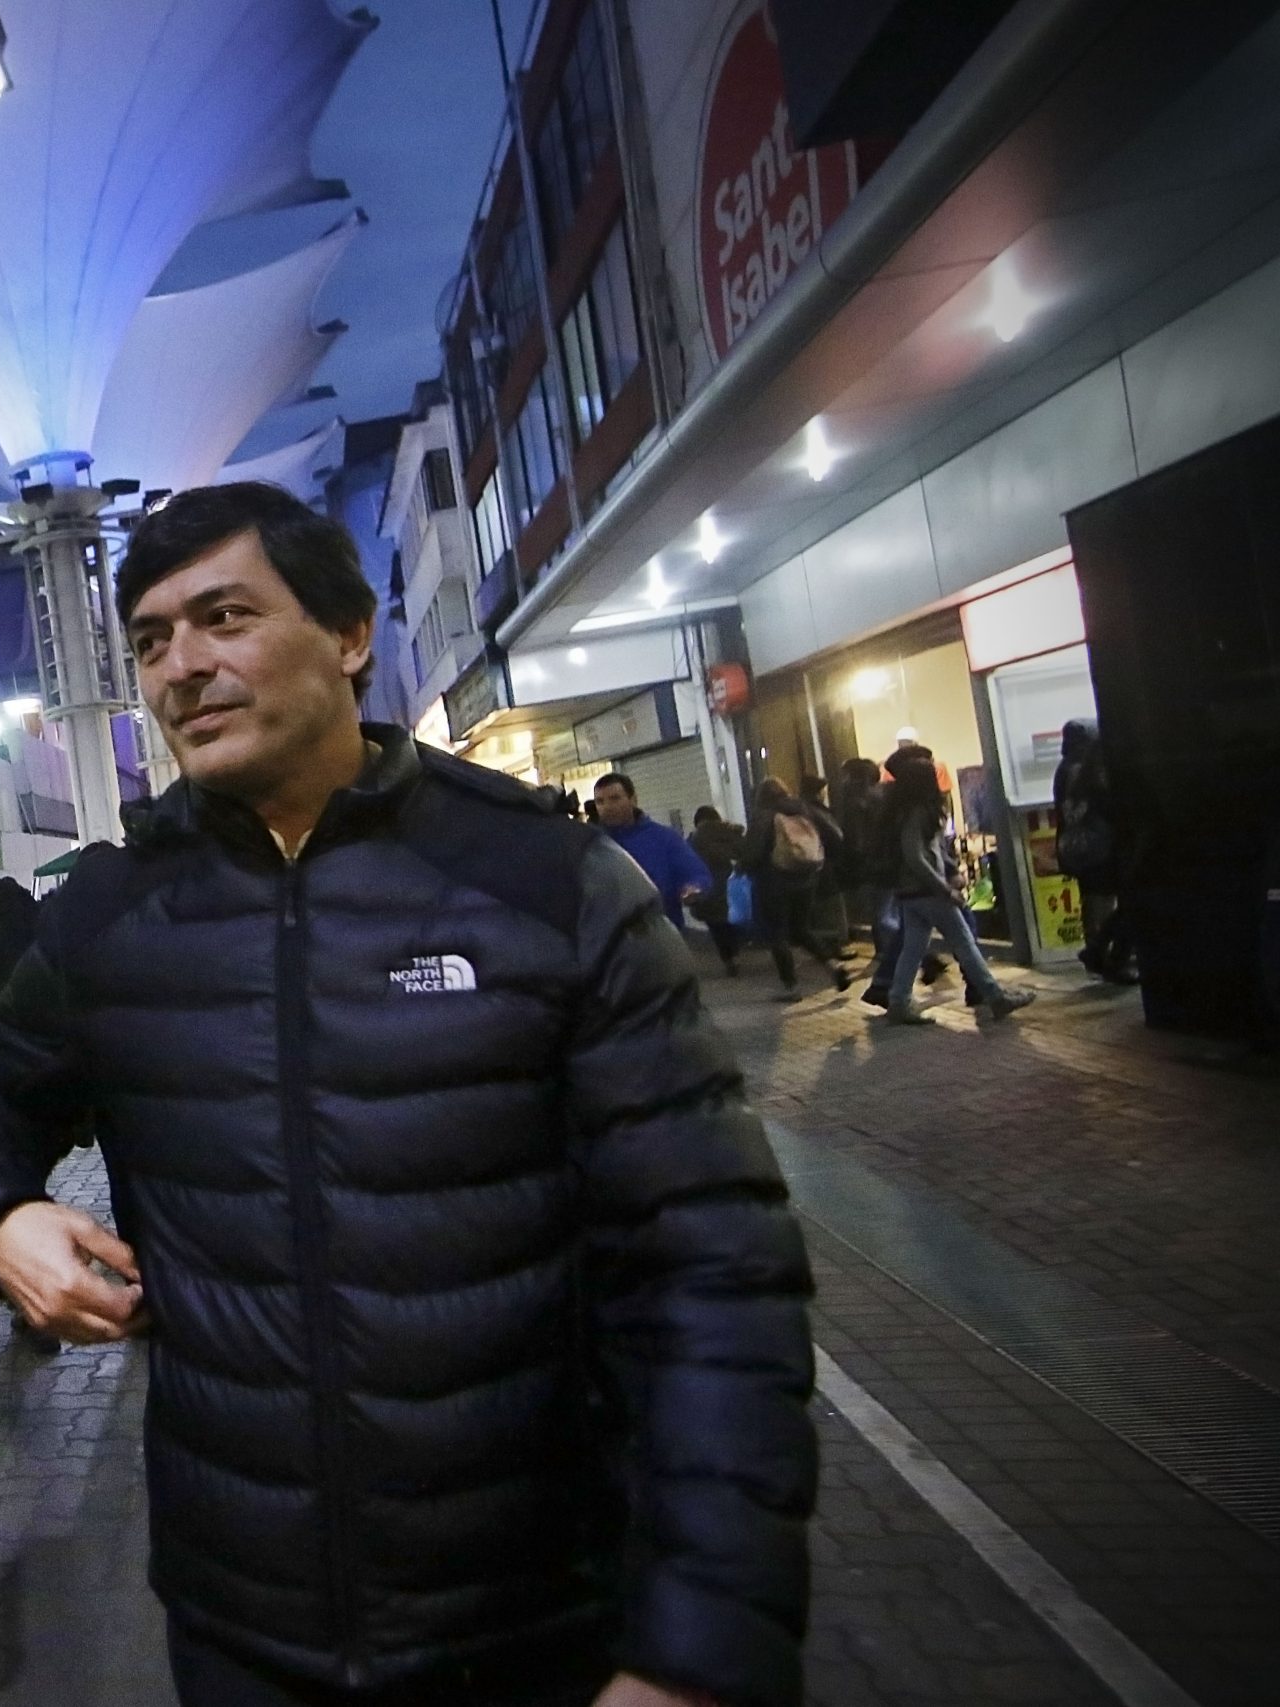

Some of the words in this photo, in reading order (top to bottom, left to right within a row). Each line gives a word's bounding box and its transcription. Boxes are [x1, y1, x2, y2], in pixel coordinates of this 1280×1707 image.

[714, 99, 805, 267] Sant
[412, 956, 440, 968] THE
[389, 968, 442, 982] NORTH
[404, 980, 444, 993] FACE
